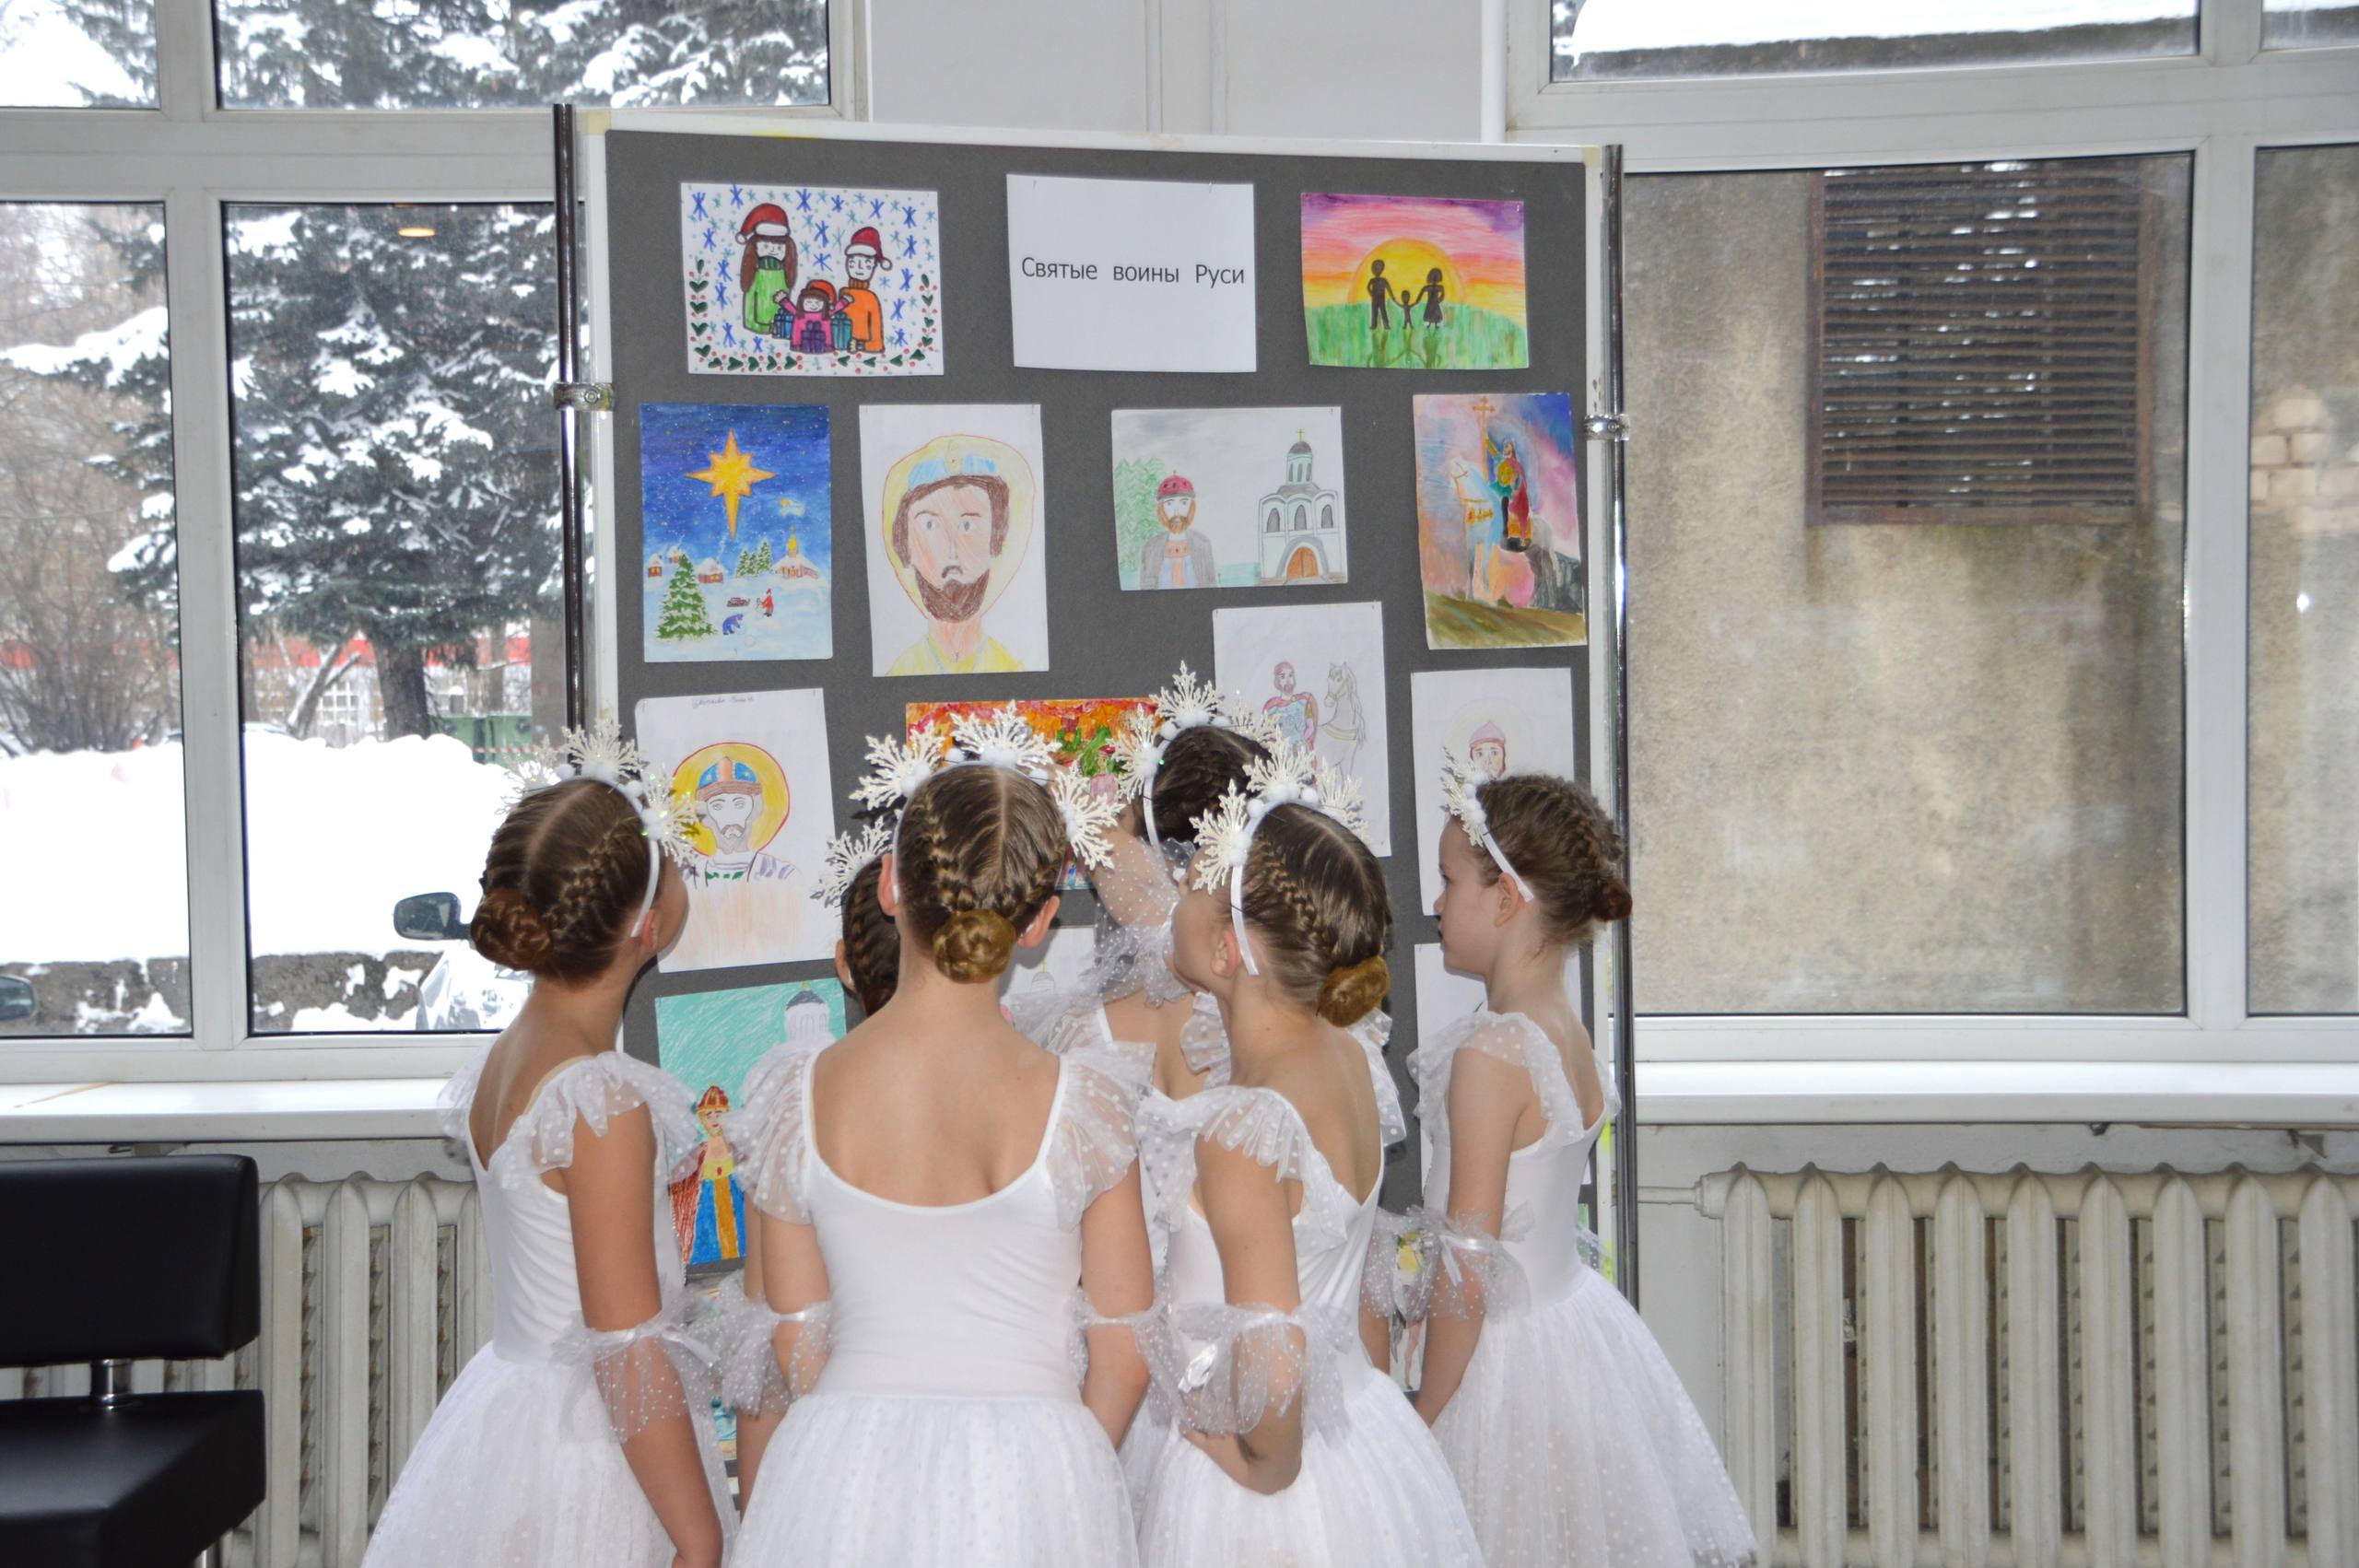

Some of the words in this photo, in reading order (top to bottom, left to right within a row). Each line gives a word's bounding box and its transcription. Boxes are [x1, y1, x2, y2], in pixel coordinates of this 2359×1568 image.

[1021, 256, 1097, 280] Святые
[1112, 265, 1180, 283] воины
[1195, 263, 1245, 288] Руси
